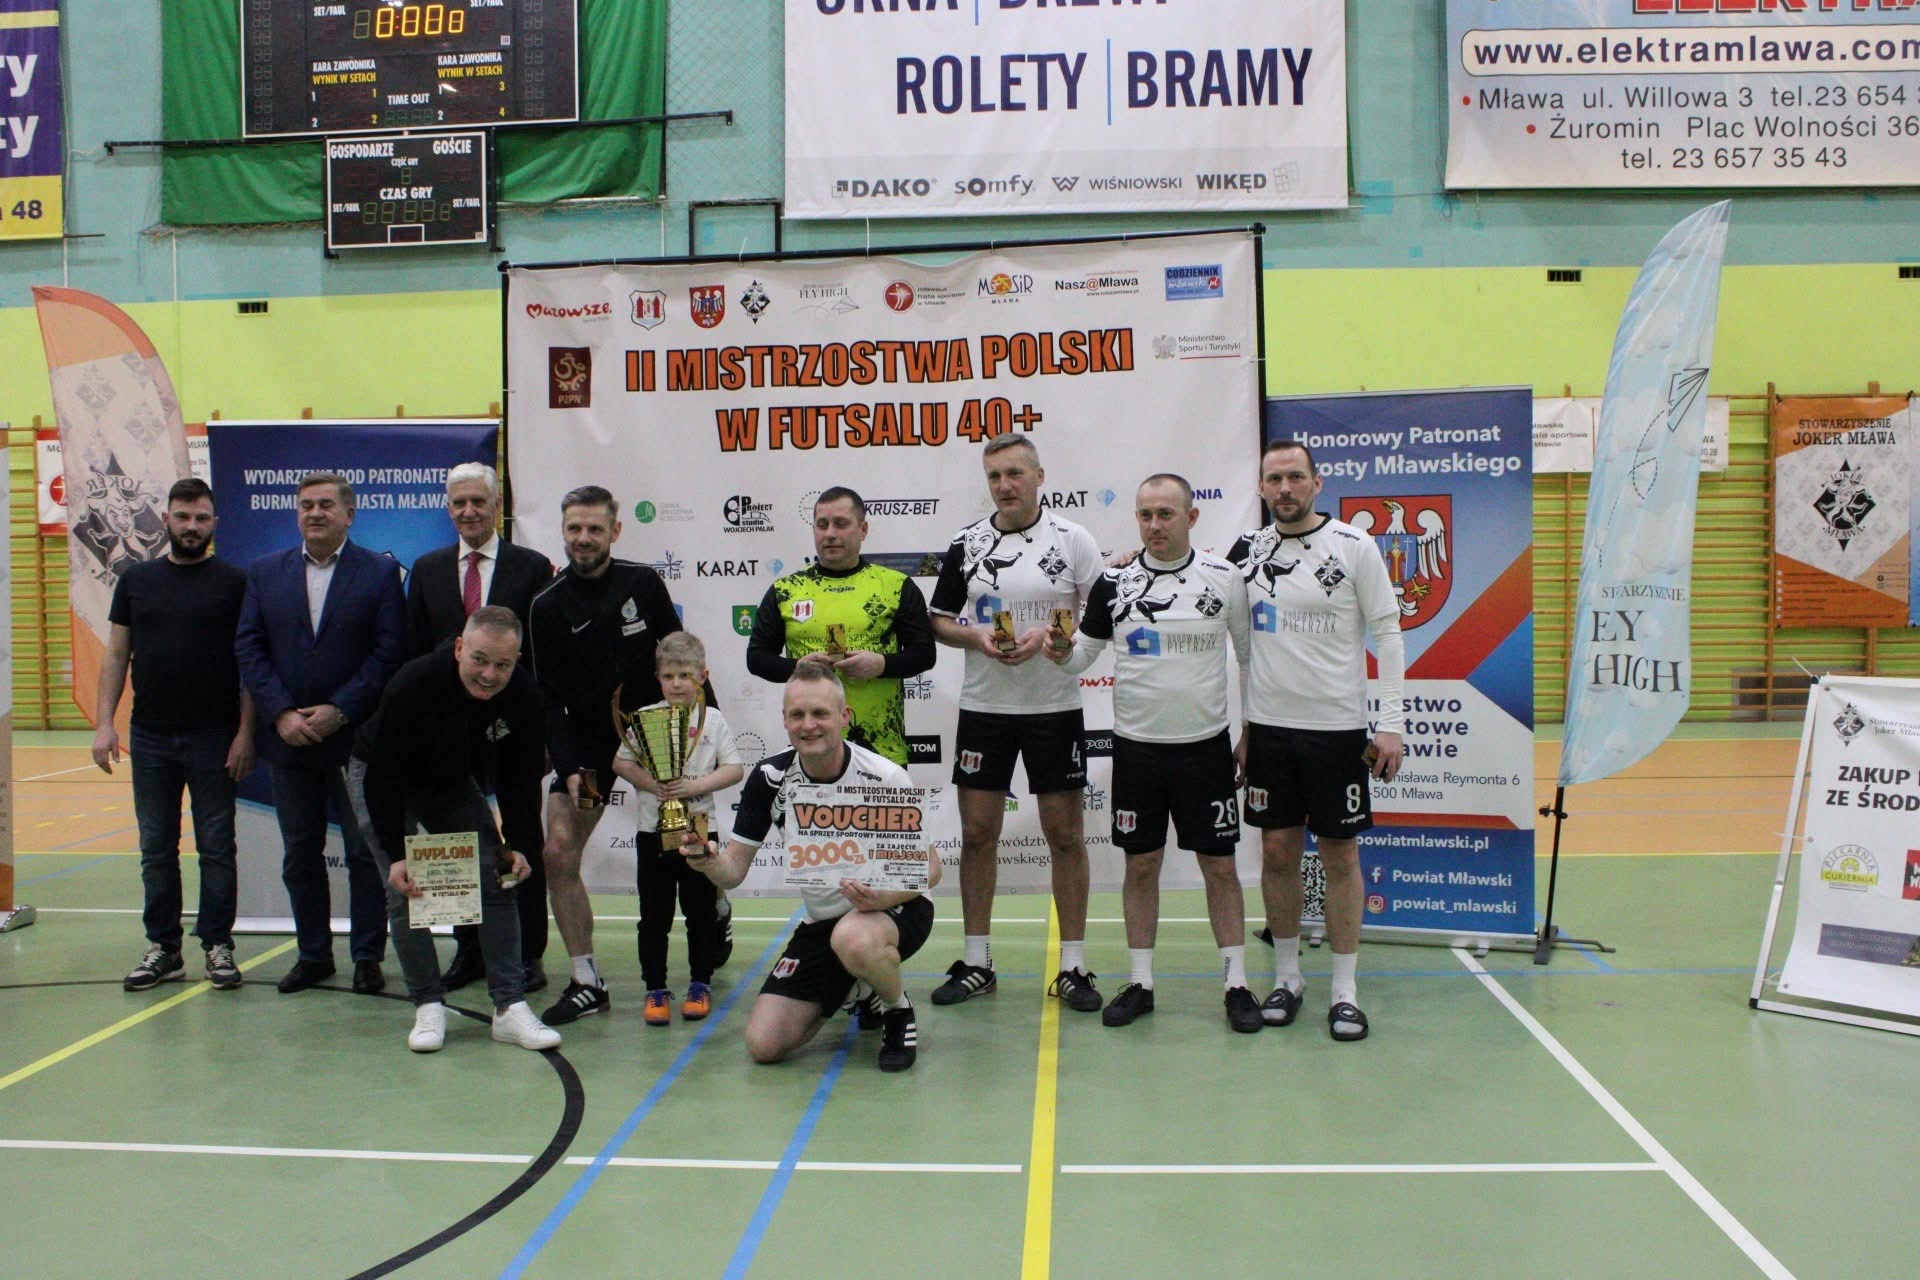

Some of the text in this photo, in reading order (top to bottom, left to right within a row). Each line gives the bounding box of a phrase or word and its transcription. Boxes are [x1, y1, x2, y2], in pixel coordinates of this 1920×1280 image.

[313, 59, 376, 72] KARA ZAWODNIKA
[438, 52, 502, 65] KARA ZAWODNIKA
[313, 72, 376, 85] WYNIK W SETACH
[438, 65, 503, 78] WYNIK W SETACH
[897, 48, 1312, 114] ROLETY BRAMY
[387, 93, 430, 105] TIME OUT
[1479, 86, 1564, 110] Mława
[1583, 86, 1613, 109] ul.
[1625, 85, 1728, 109] Willowa
[1738, 87, 1753, 107] 3
[1857, 84, 1907, 106] 654
[312, 114, 378, 128] 2 2
[438, 111, 443, 120] 2
[1550, 113, 1660, 139] Żuromin
[1687, 117, 1745, 138] Plac
[1755, 115, 1876, 138] Wolności
[330, 137, 472, 159] GOSPODARZE GOŚCIE
[1621, 147, 1847, 168] tel. 23 657 35 43
[380, 186, 433, 200] CZAS GRY
[954, 175, 1033, 196] somfy
[1089, 176, 1182, 190] WIŚNIOWSKI
[1197, 174, 1267, 193] WIKĘD
[11, 200, 43, 220] 48
[1167, 267, 1218, 279] CODZIENNIK
[1055, 277, 1138, 291] Nasz@Mława
[625, 328, 1134, 392] II MISTRZOSTWA POLSKI
[715, 396, 1042, 452] W FUTSALU 40+
[1799, 417, 1891, 429] STOWARZYSZENIE
[1293, 425, 1501, 450] Honorowy Patronat
[1793, 431, 1896, 446] JOKER MŁAWA
[1375, 452, 1521, 477] Mławskiego
[245, 469, 334, 485] WYDARZ
[356, 494, 394, 510] IASTA
[864, 499, 939, 516] KRUSZ-BET
[1039, 491, 1088, 509] ARAT
[697, 560, 758, 577] KARAT
[1591, 653, 1682, 692] HIGH
[1072, 741, 1081, 768] 4
[1444, 772, 1521, 788] Reymonta 6
[1838, 765, 1911, 785] ZAKUP
[844, 786, 898, 796] MISTRZOSTWA
[899, 787, 925, 797] POLSKI
[864, 795, 871, 803] W
[872, 795, 905, 804] FUTSALU
[906, 795, 922, 804] 40+
[1346, 783, 1361, 813] 8
[1402, 786, 1443, 800] Mława
[1826, 789, 1850, 807] ZE
[793, 803, 923, 833] VOUCHER
[1211, 798, 1237, 829] 28
[836, 831, 874, 839] SPORTOWY
[788, 839, 860, 869] 3000
[1393, 869, 1512, 887] Powiat Mławski
[1825, 871, 1873, 884] CUKIERNIA
[1393, 897, 1517, 914] powiat_mlawski
